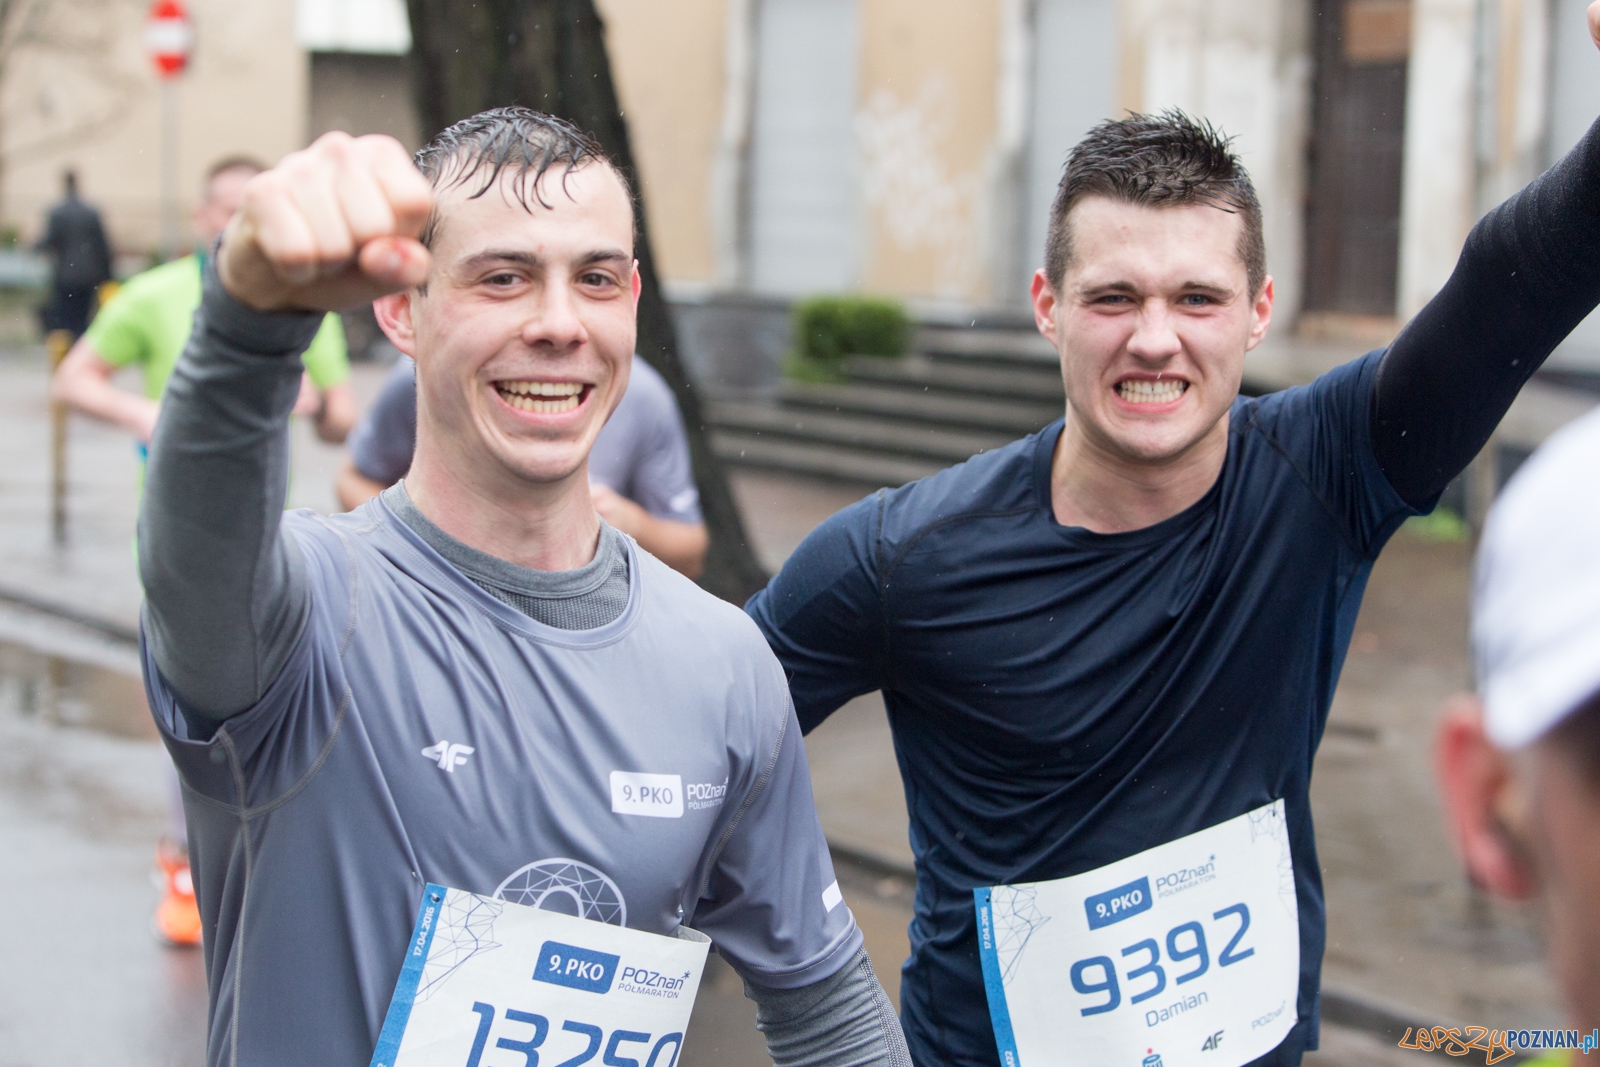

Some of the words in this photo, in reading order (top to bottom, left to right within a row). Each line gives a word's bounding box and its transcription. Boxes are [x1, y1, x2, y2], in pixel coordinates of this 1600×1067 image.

[421, 740, 475, 773] 4F
[640, 786, 673, 804] PKO
[1110, 889, 1143, 914] PKO
[413, 906, 435, 957] 17.04.2016
[980, 906, 991, 950] 17.04.2016
[565, 958, 605, 981] PKO
[1069, 902, 1255, 1018] 9392
[618, 983, 679, 999] PÓŁMARATON
[1145, 991, 1209, 1028] Damian
